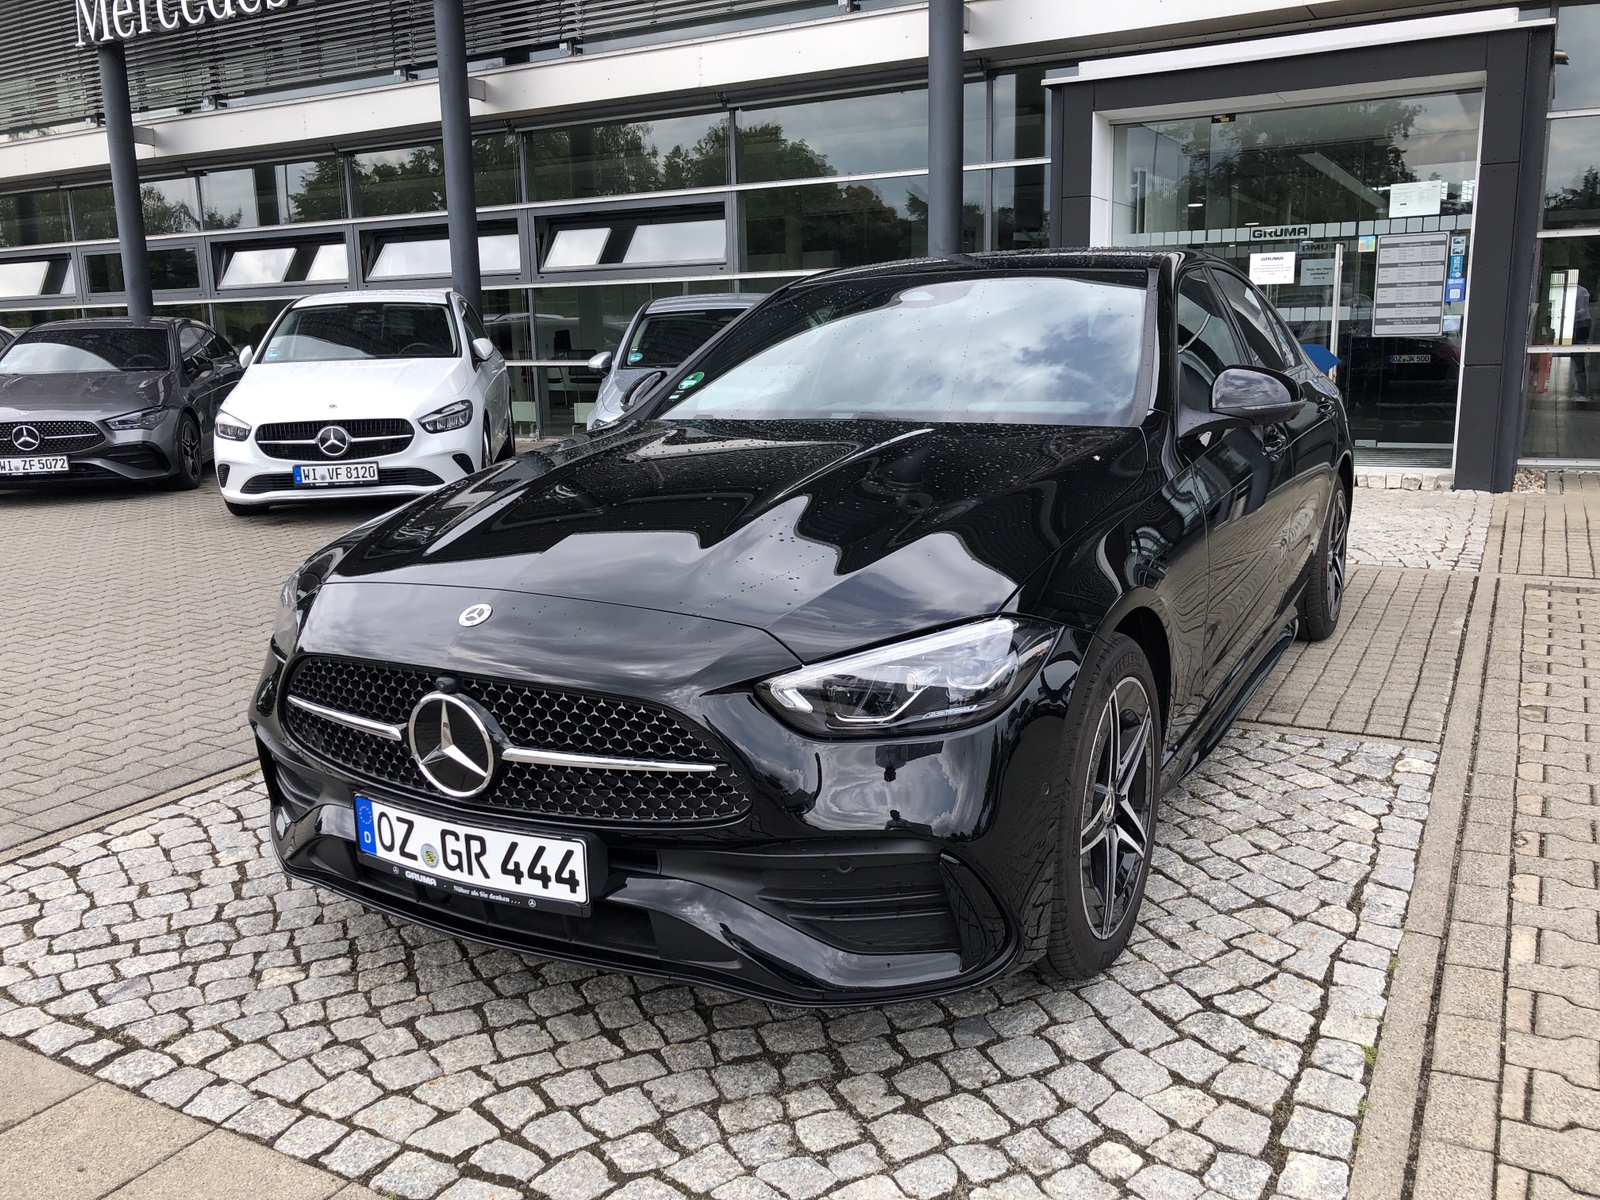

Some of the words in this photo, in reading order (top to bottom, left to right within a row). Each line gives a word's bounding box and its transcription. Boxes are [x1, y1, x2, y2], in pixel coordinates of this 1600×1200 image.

[1252, 227, 1308, 238] GRUMA
[21, 460, 35, 470] ZF
[38, 458, 66, 469] 5072
[303, 468, 317, 481] WI
[327, 467, 342, 480] VF
[345, 466, 376, 479] 8120
[364, 831, 371, 844] D
[377, 811, 418, 862] OZ
[440, 828, 491, 879] GR
[500, 841, 580, 894] 444
[405, 870, 437, 887] GRUMA
[453, 885, 470, 895] Näher
